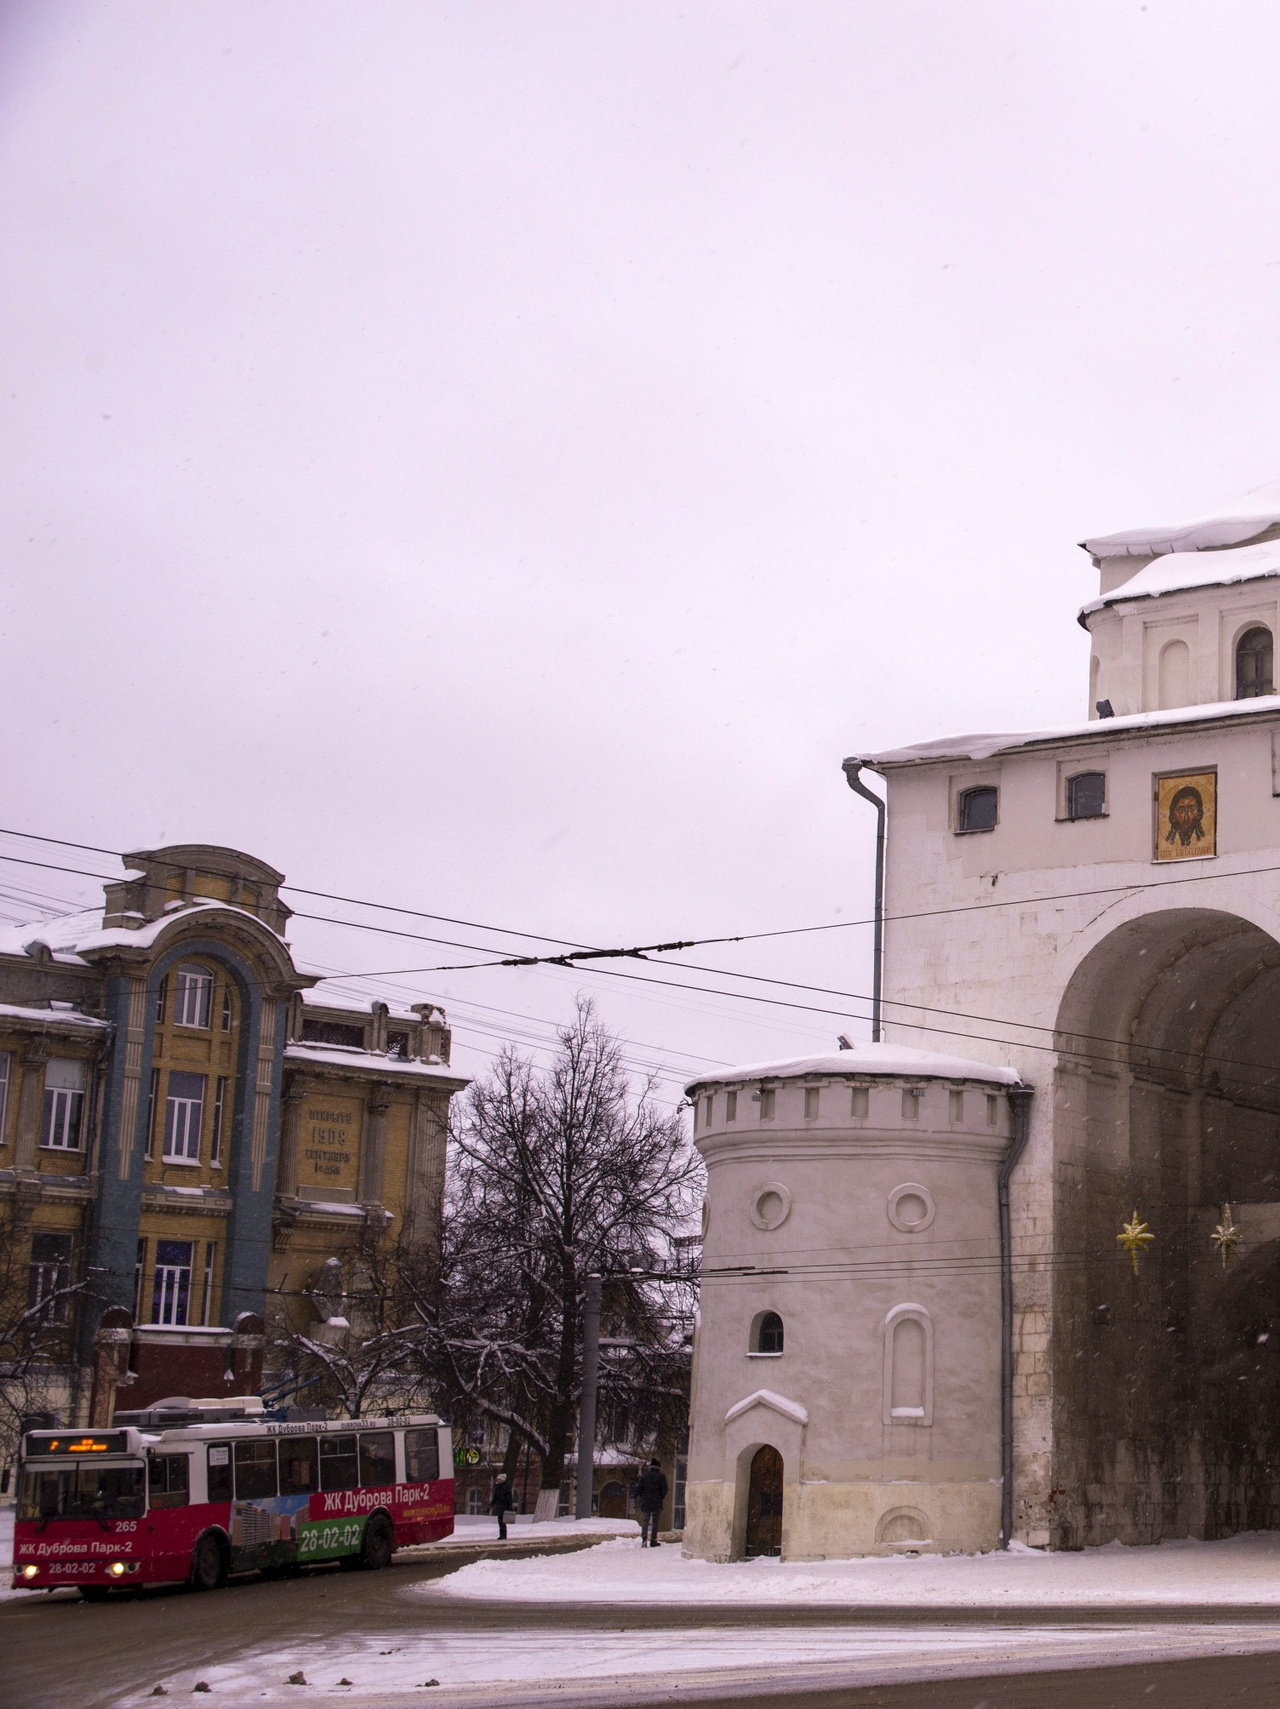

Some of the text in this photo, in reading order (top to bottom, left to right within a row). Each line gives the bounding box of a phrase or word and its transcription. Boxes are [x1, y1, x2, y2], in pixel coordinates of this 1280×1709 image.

[312, 1127, 347, 1145] 1908
[266, 1422, 328, 1434] ЖК Дуброва Парк-2
[387, 1416, 411, 1427] 28-02-02
[324, 1483, 430, 1512] ЖК Дуброва Парк-2
[115, 1521, 137, 1532] 265
[301, 1524, 360, 1552] 28-02-02
[19, 1541, 132, 1556] ЖК Дуброва Парк-2
[49, 1562, 96, 1574] 28-02-02
